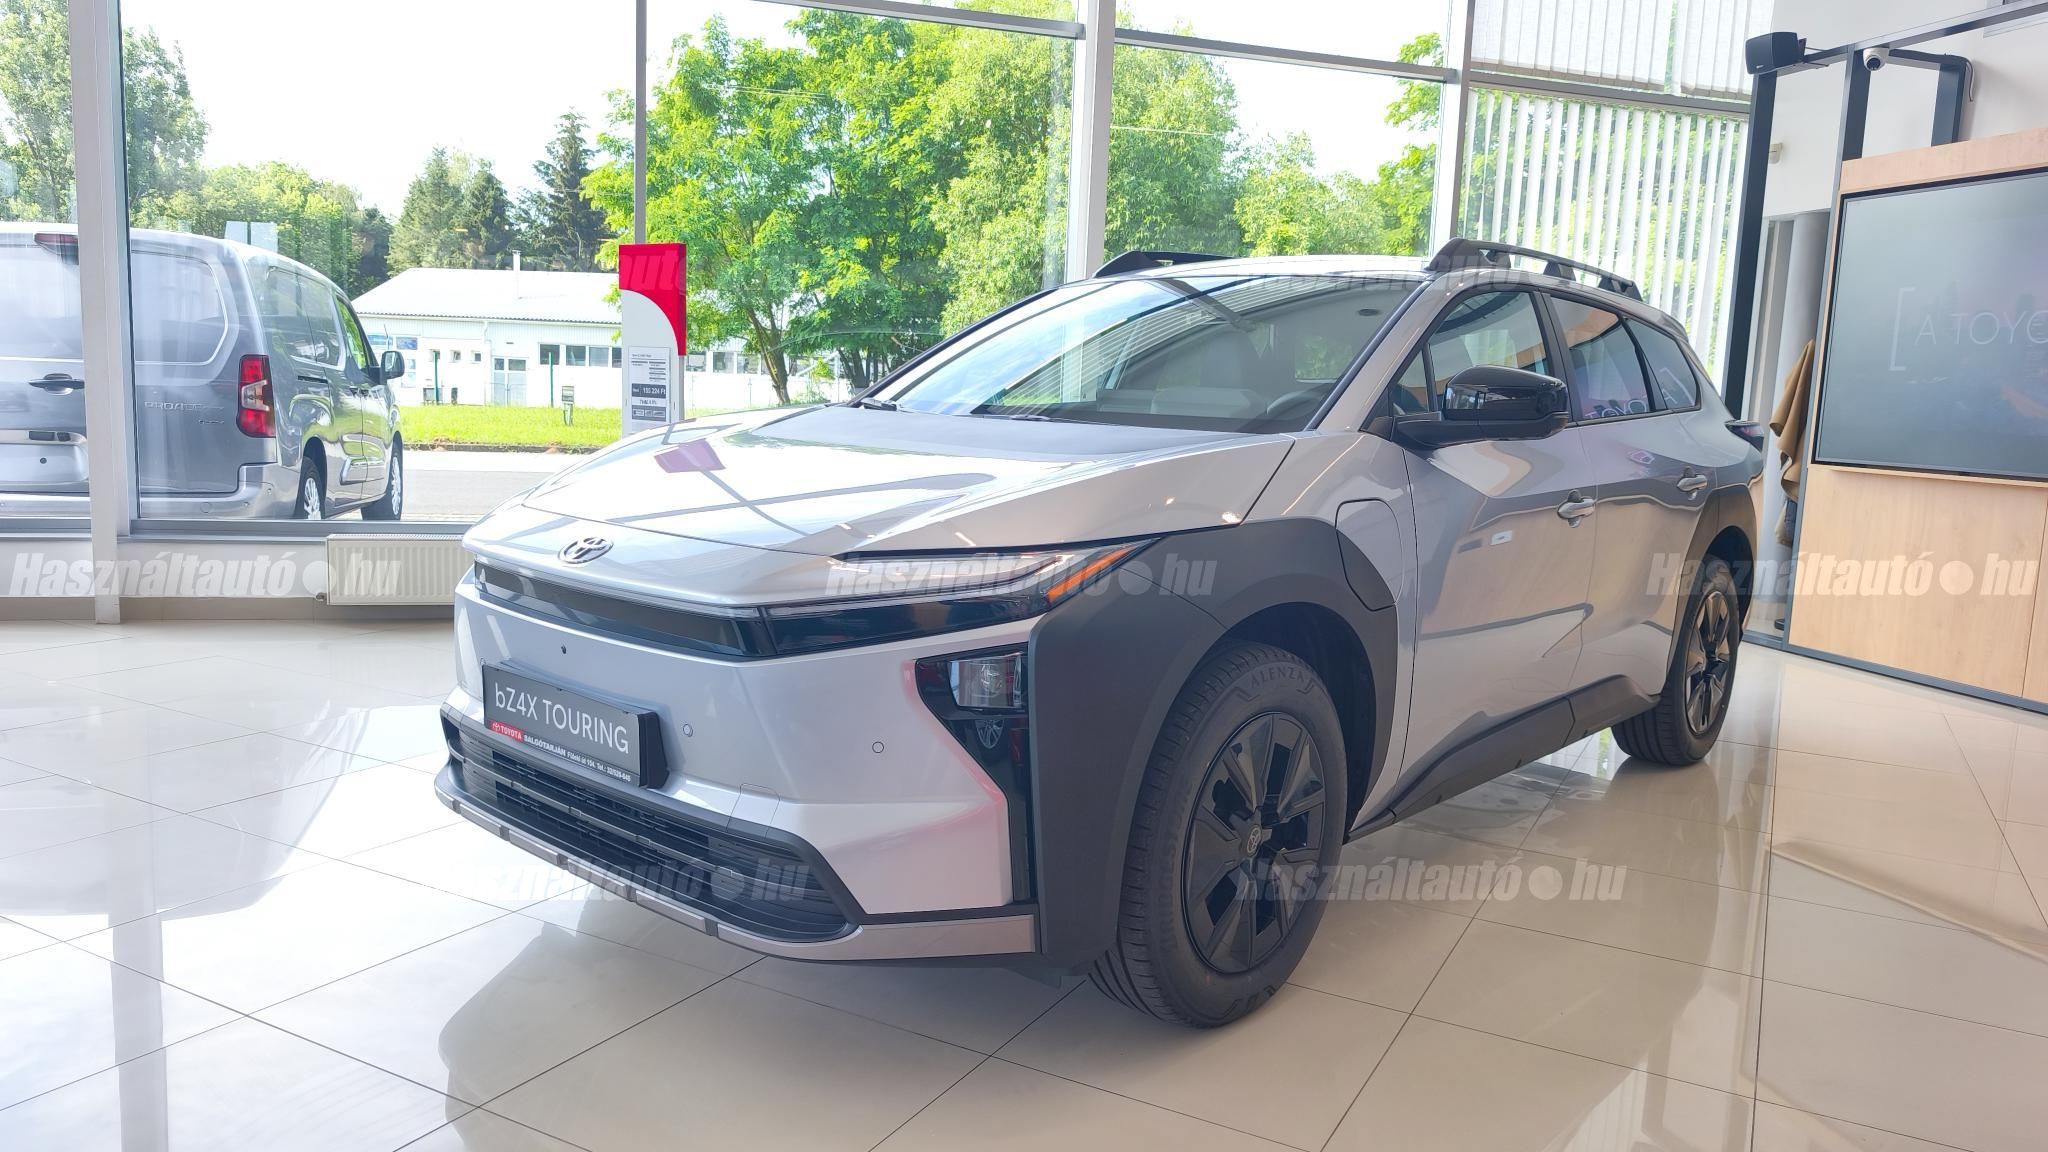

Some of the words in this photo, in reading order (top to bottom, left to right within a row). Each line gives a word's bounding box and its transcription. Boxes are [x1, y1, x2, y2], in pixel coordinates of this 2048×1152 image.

[1914, 314, 1937, 345] A
[1251, 665, 1305, 688] ALENZA
[495, 682, 538, 721] bZ4X
[543, 699, 629, 754] TOURING
[500, 725, 522, 741] TOYOTA
